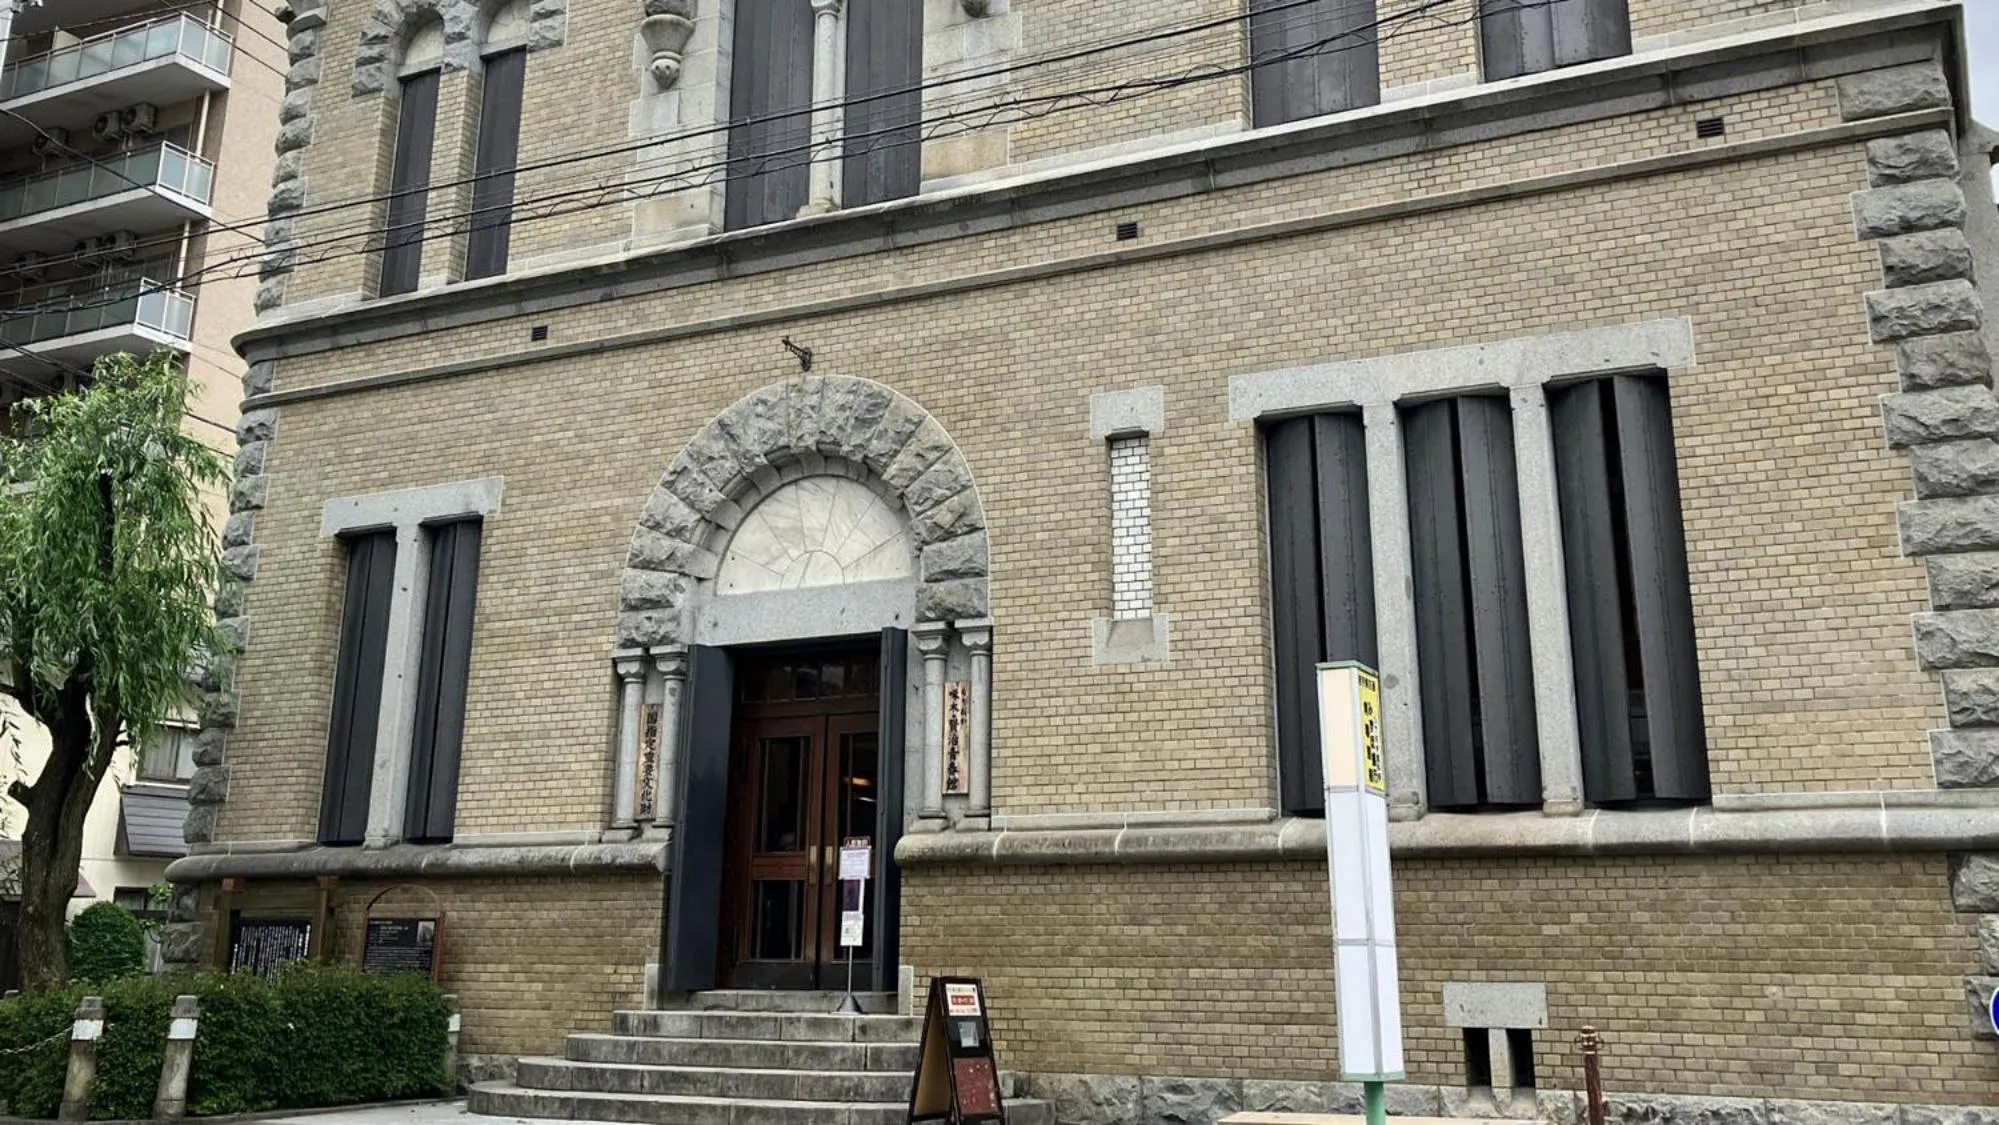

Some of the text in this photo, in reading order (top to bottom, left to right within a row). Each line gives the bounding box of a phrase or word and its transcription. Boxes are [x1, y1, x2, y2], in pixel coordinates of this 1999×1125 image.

[640, 711, 659, 815] 国指定重要文化財
